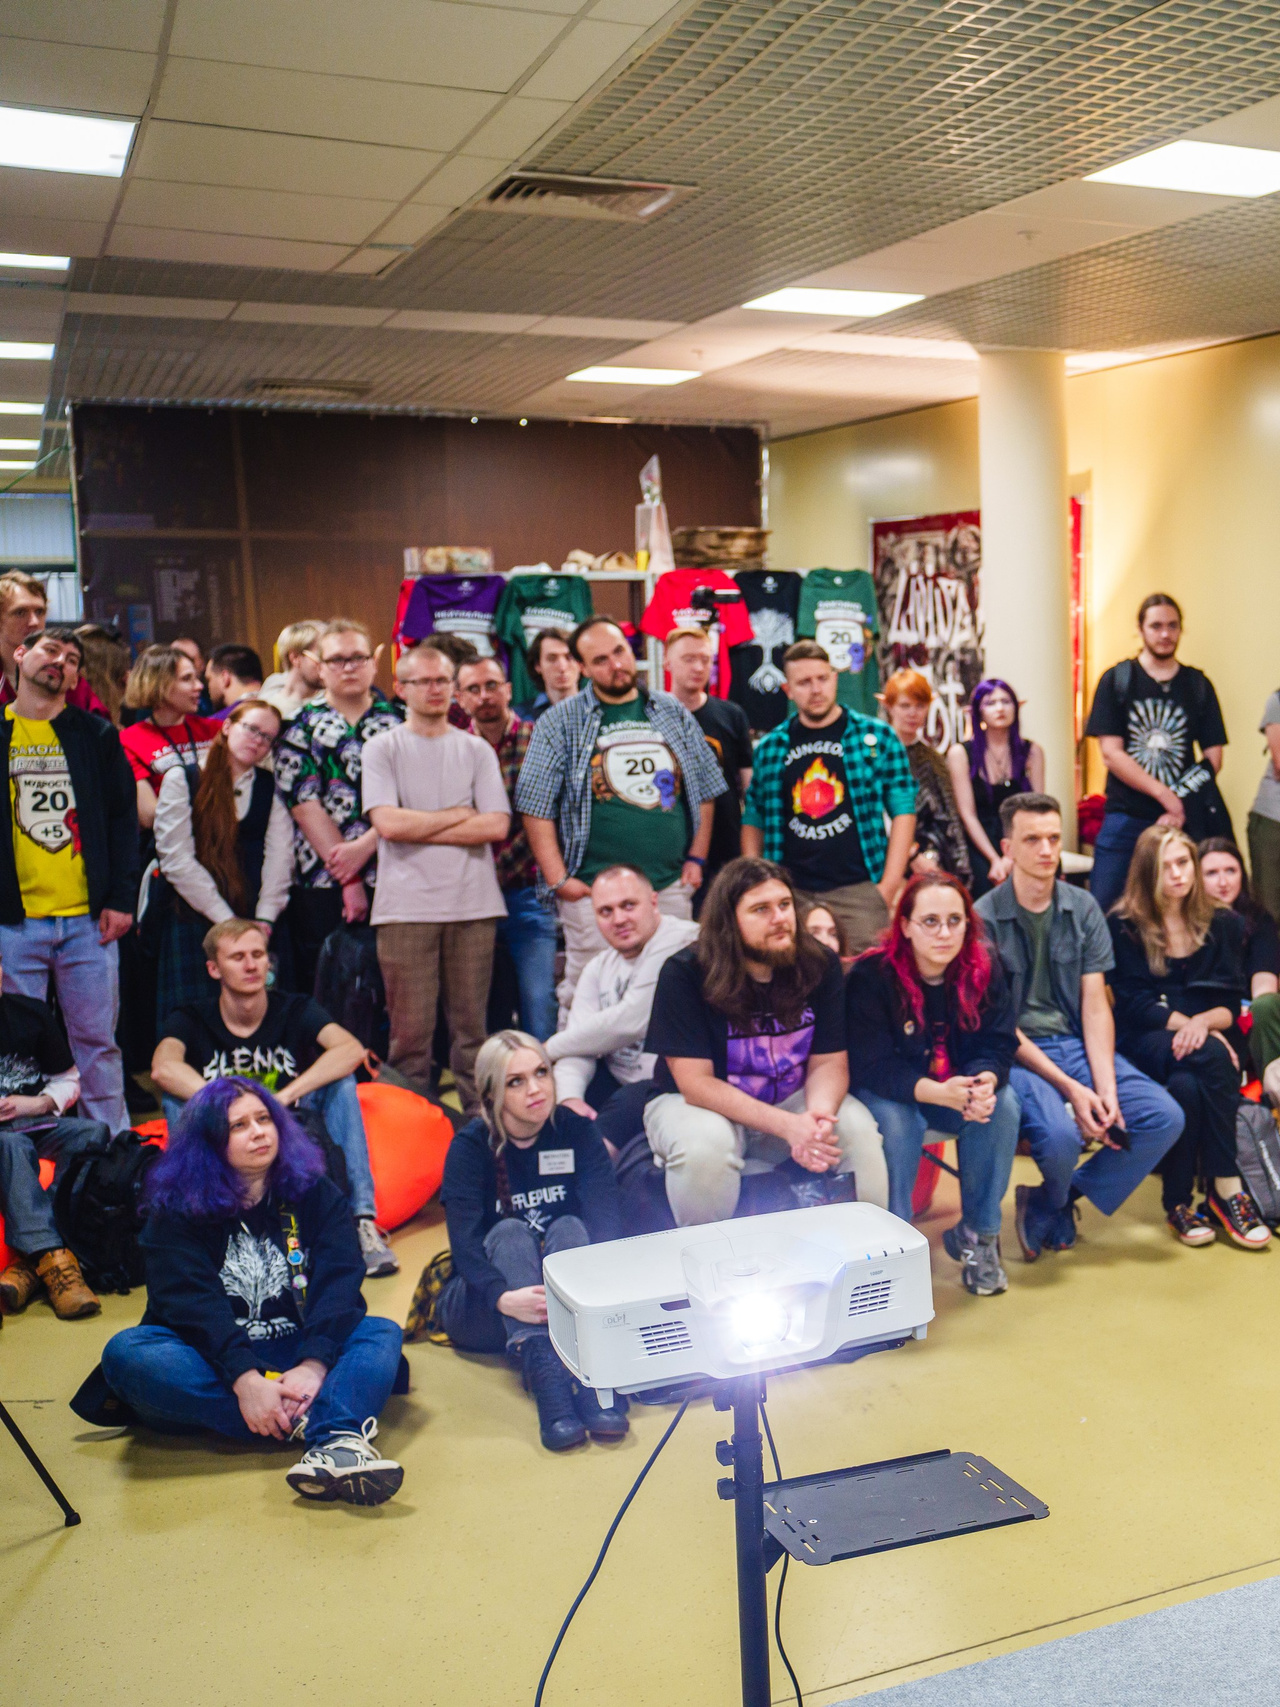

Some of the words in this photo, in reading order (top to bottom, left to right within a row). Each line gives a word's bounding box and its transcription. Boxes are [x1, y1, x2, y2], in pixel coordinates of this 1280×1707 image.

[830, 631, 851, 645] 20
[10, 744, 64, 756] ЗАКОН
[626, 757, 655, 776] 20
[31, 790, 69, 812] 20
[41, 825, 64, 838] +5
